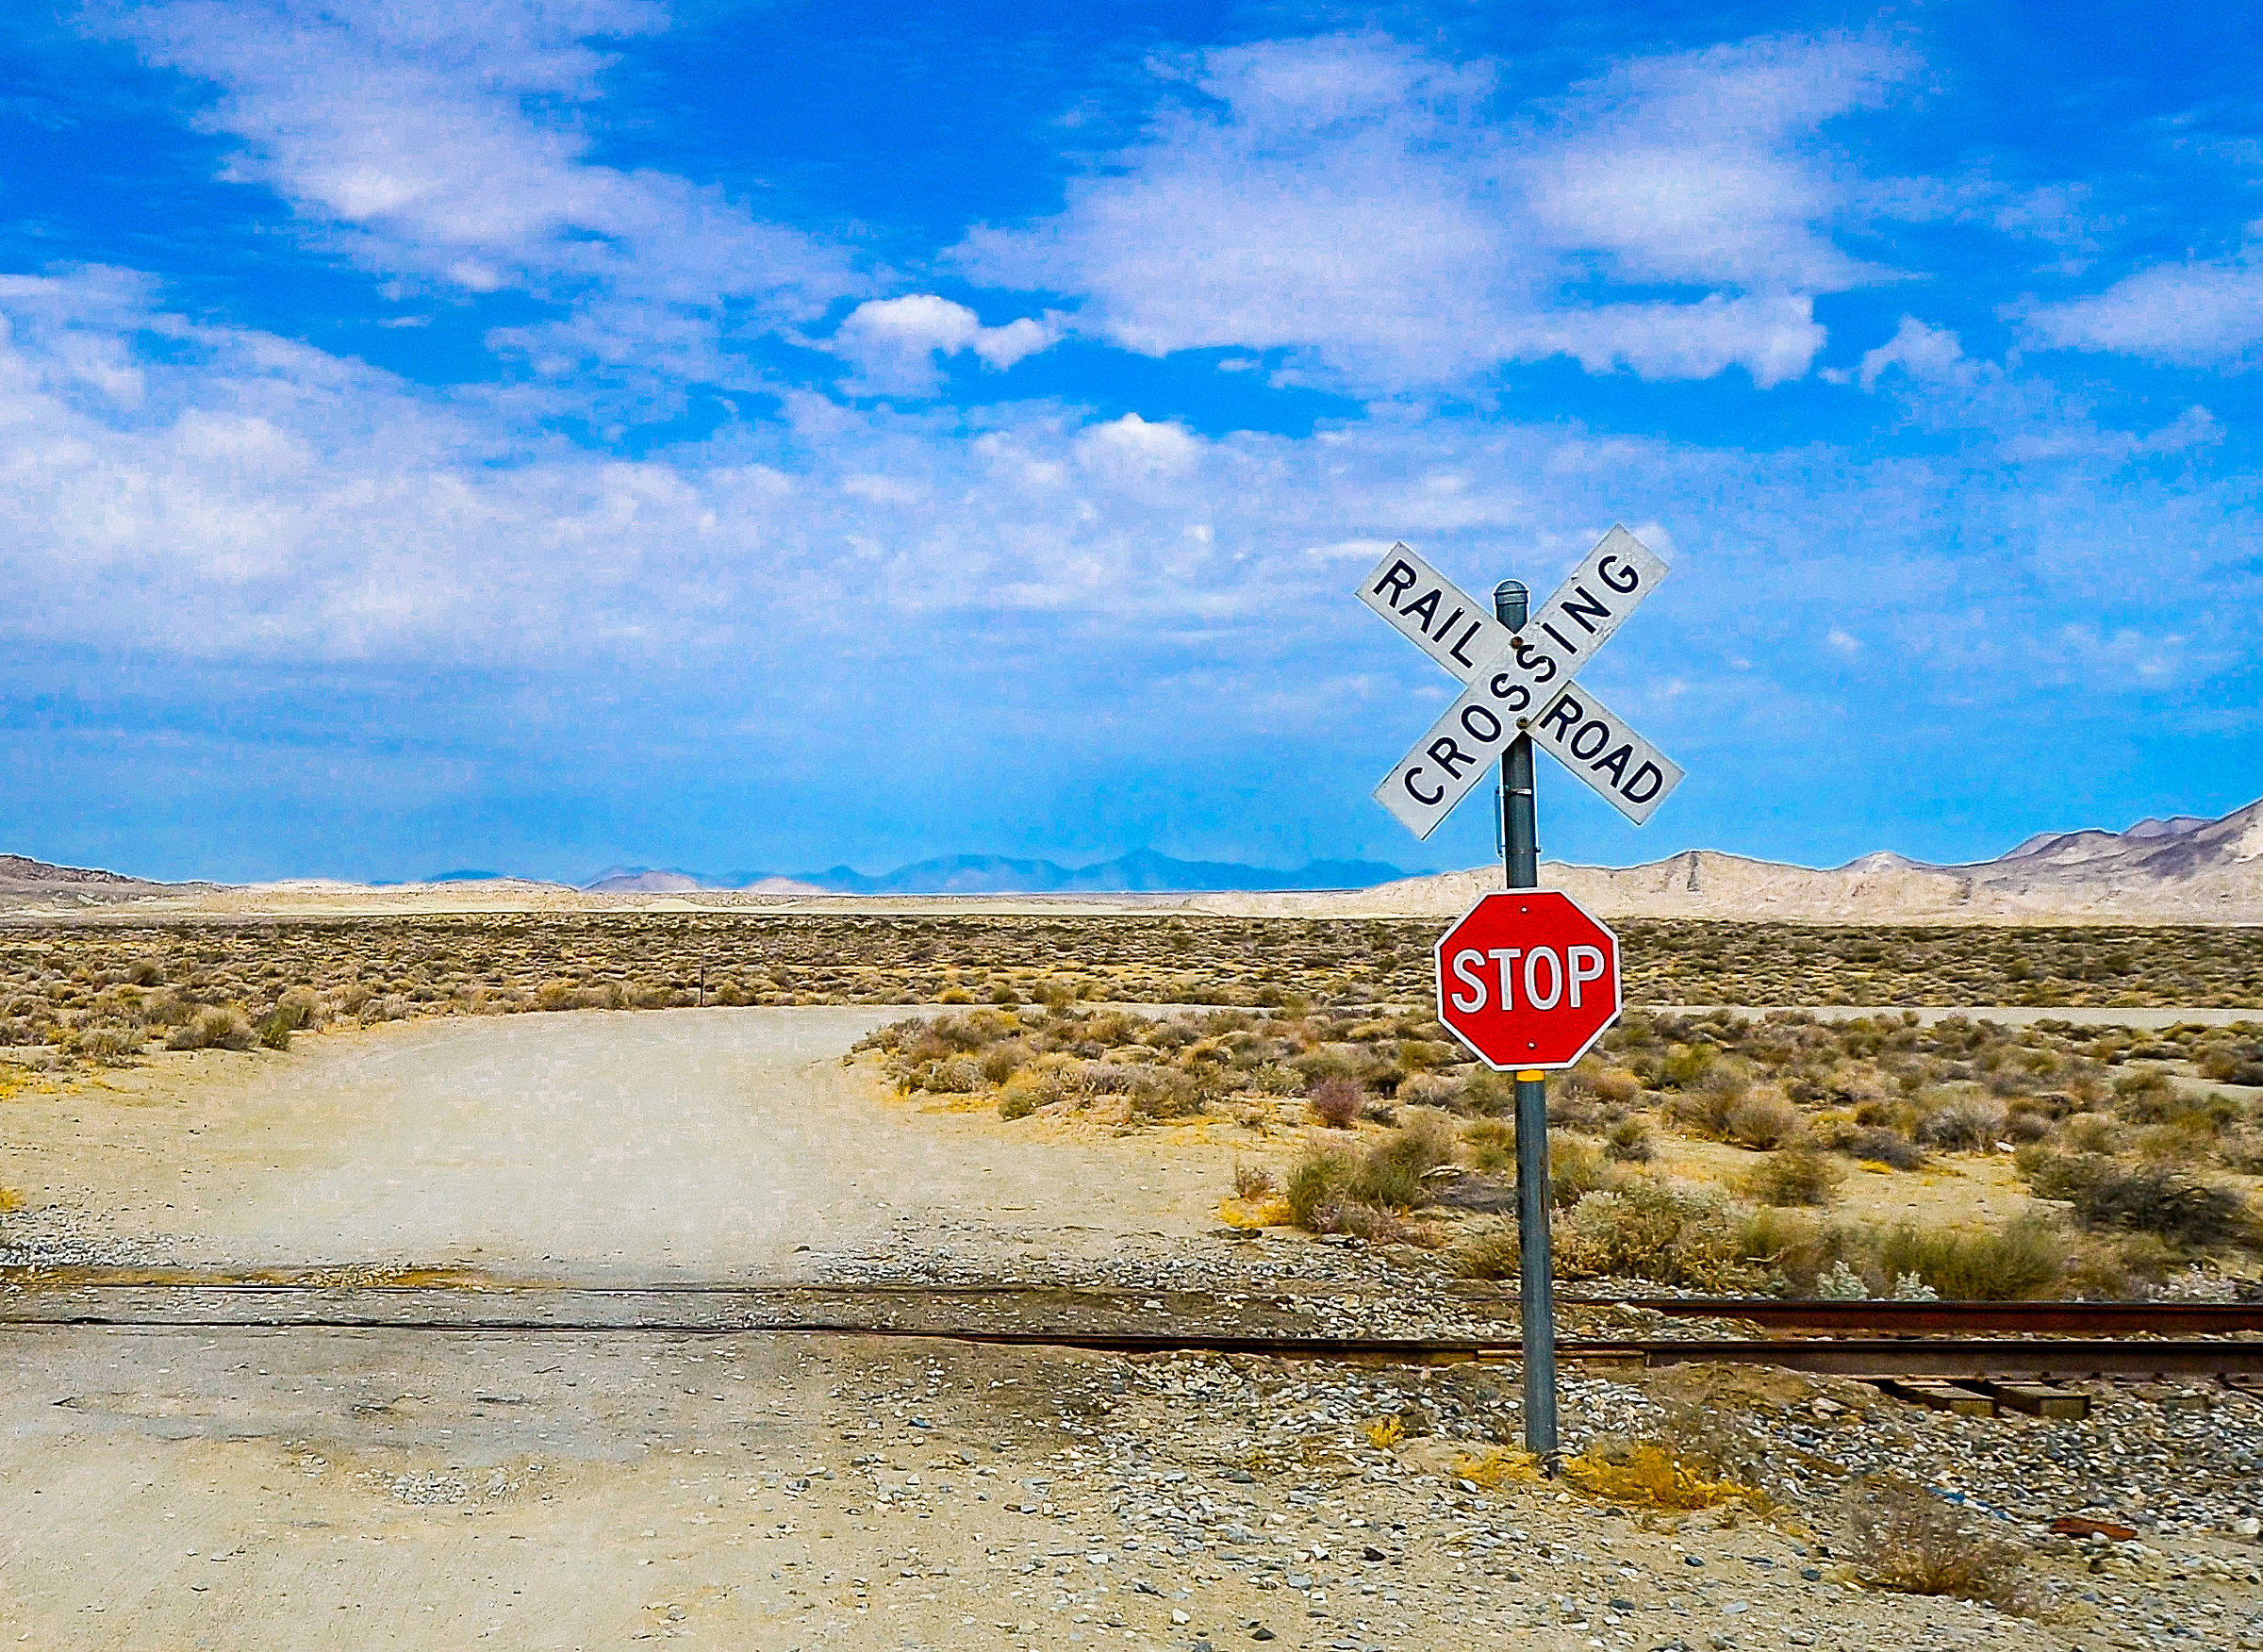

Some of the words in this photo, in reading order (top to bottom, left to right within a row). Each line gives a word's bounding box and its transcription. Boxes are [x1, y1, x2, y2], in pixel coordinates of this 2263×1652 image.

[1372, 558, 1482, 669] RAIL
[1538, 693, 1663, 804] ROAD
[1403, 554, 1640, 806] CROSSING
[1451, 945, 1605, 1014] STOP
